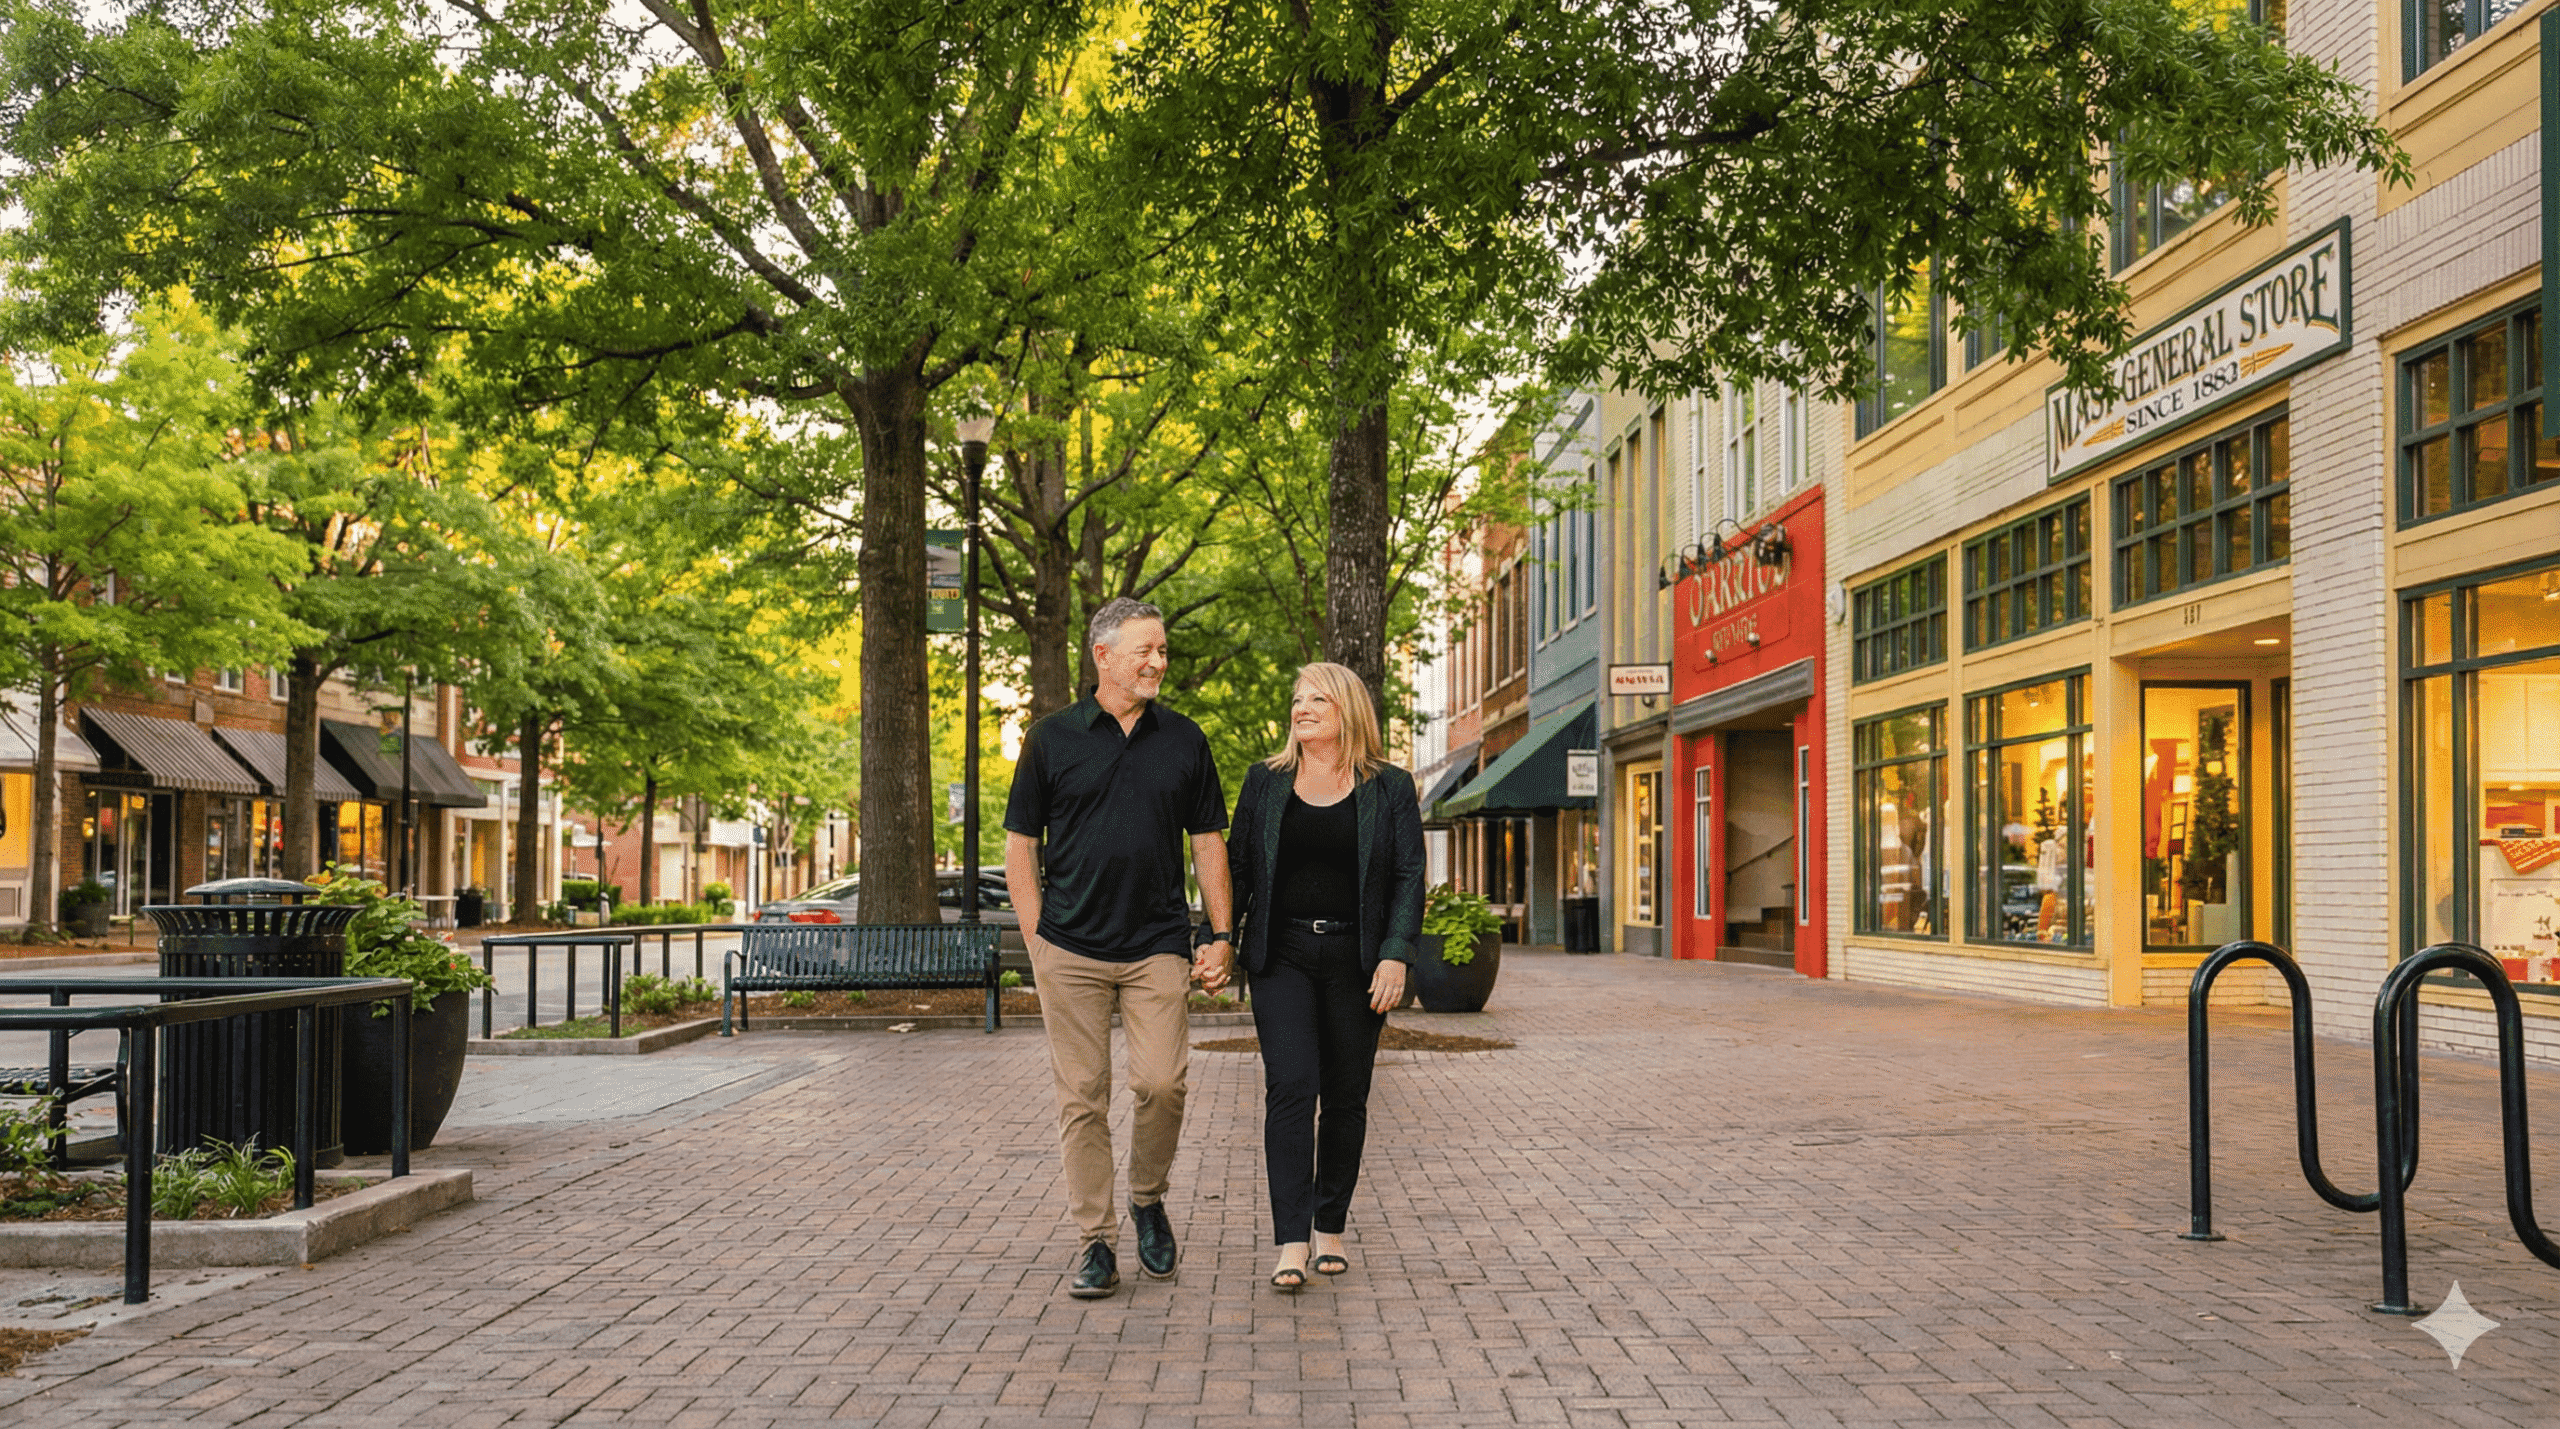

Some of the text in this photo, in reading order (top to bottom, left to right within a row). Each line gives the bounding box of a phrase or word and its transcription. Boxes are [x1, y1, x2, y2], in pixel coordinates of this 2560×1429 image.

[2053, 242, 2340, 472] MAS GENERAL STORE
[2125, 388, 2184, 434] SINCE
